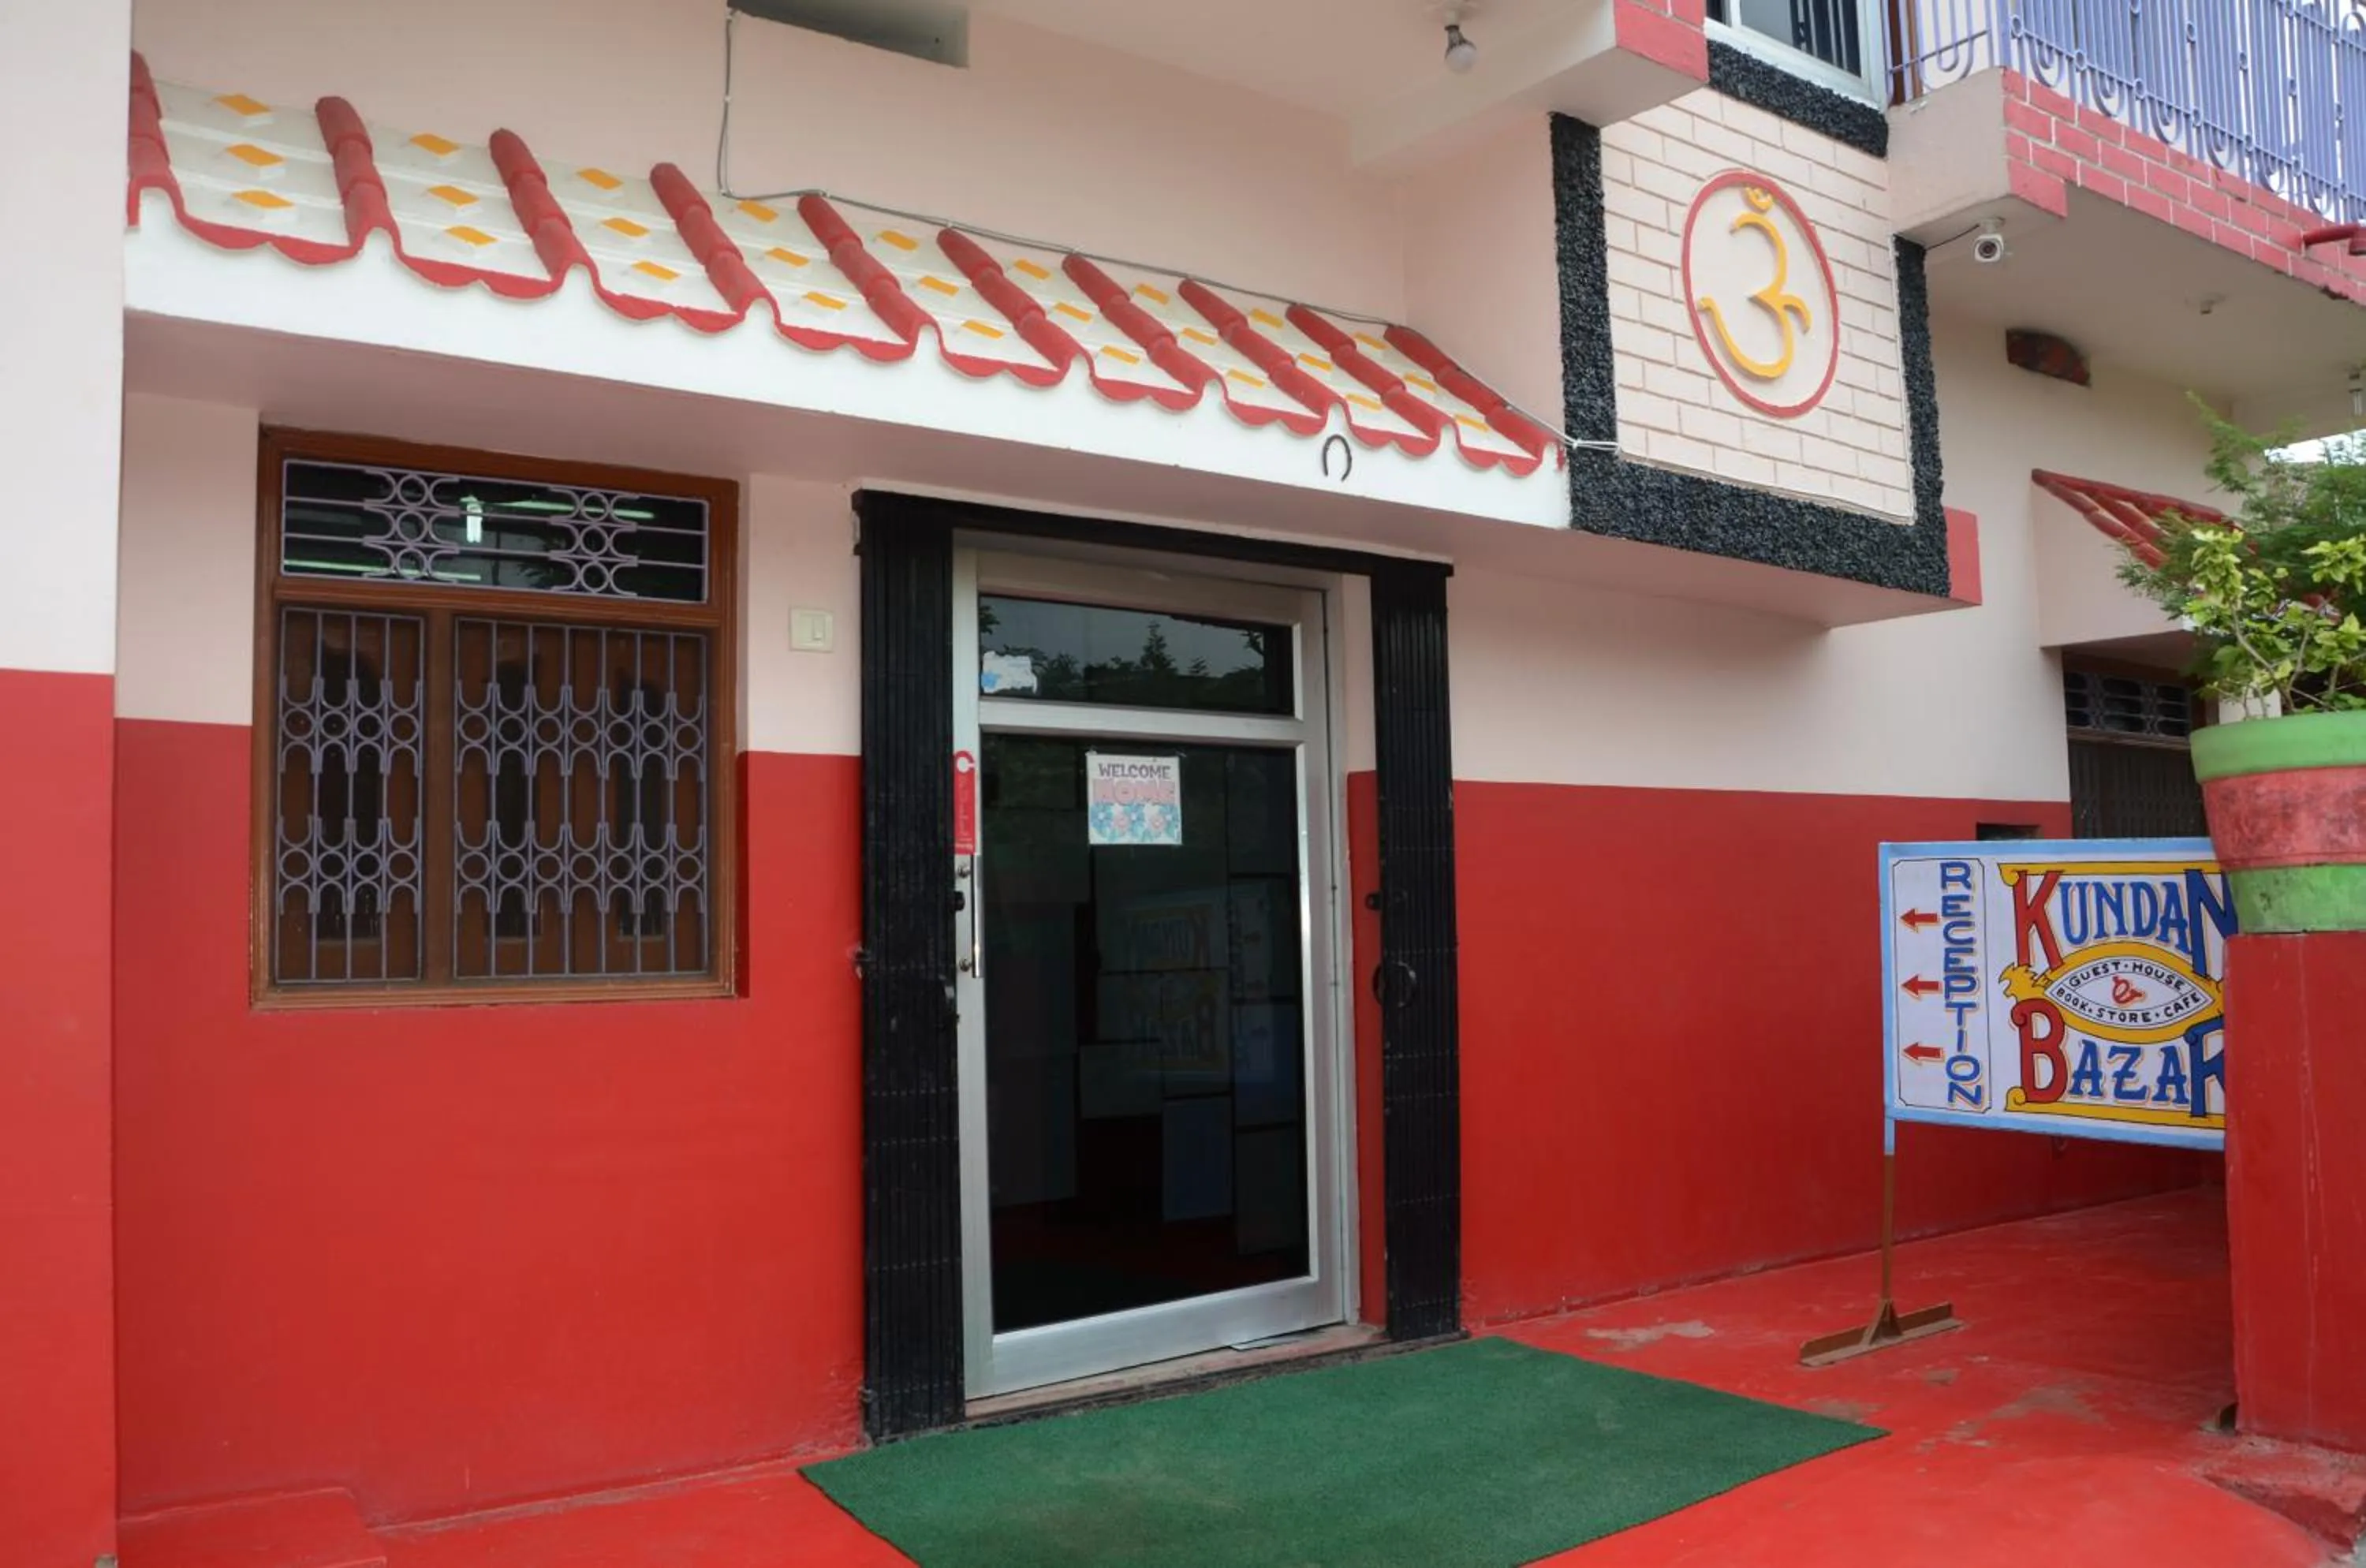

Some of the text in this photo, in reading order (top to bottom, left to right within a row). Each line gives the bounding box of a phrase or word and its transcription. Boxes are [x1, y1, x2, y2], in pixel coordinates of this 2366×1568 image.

[1099, 763, 1172, 779] WELCOME
[2012, 869, 2238, 978] KUNDAN
[1940, 861, 1982, 1106] RECEPTION
[2068, 961, 2186, 992] GUEST HOUSE
[2055, 987, 2202, 1024] BOOK STORE CAFE
